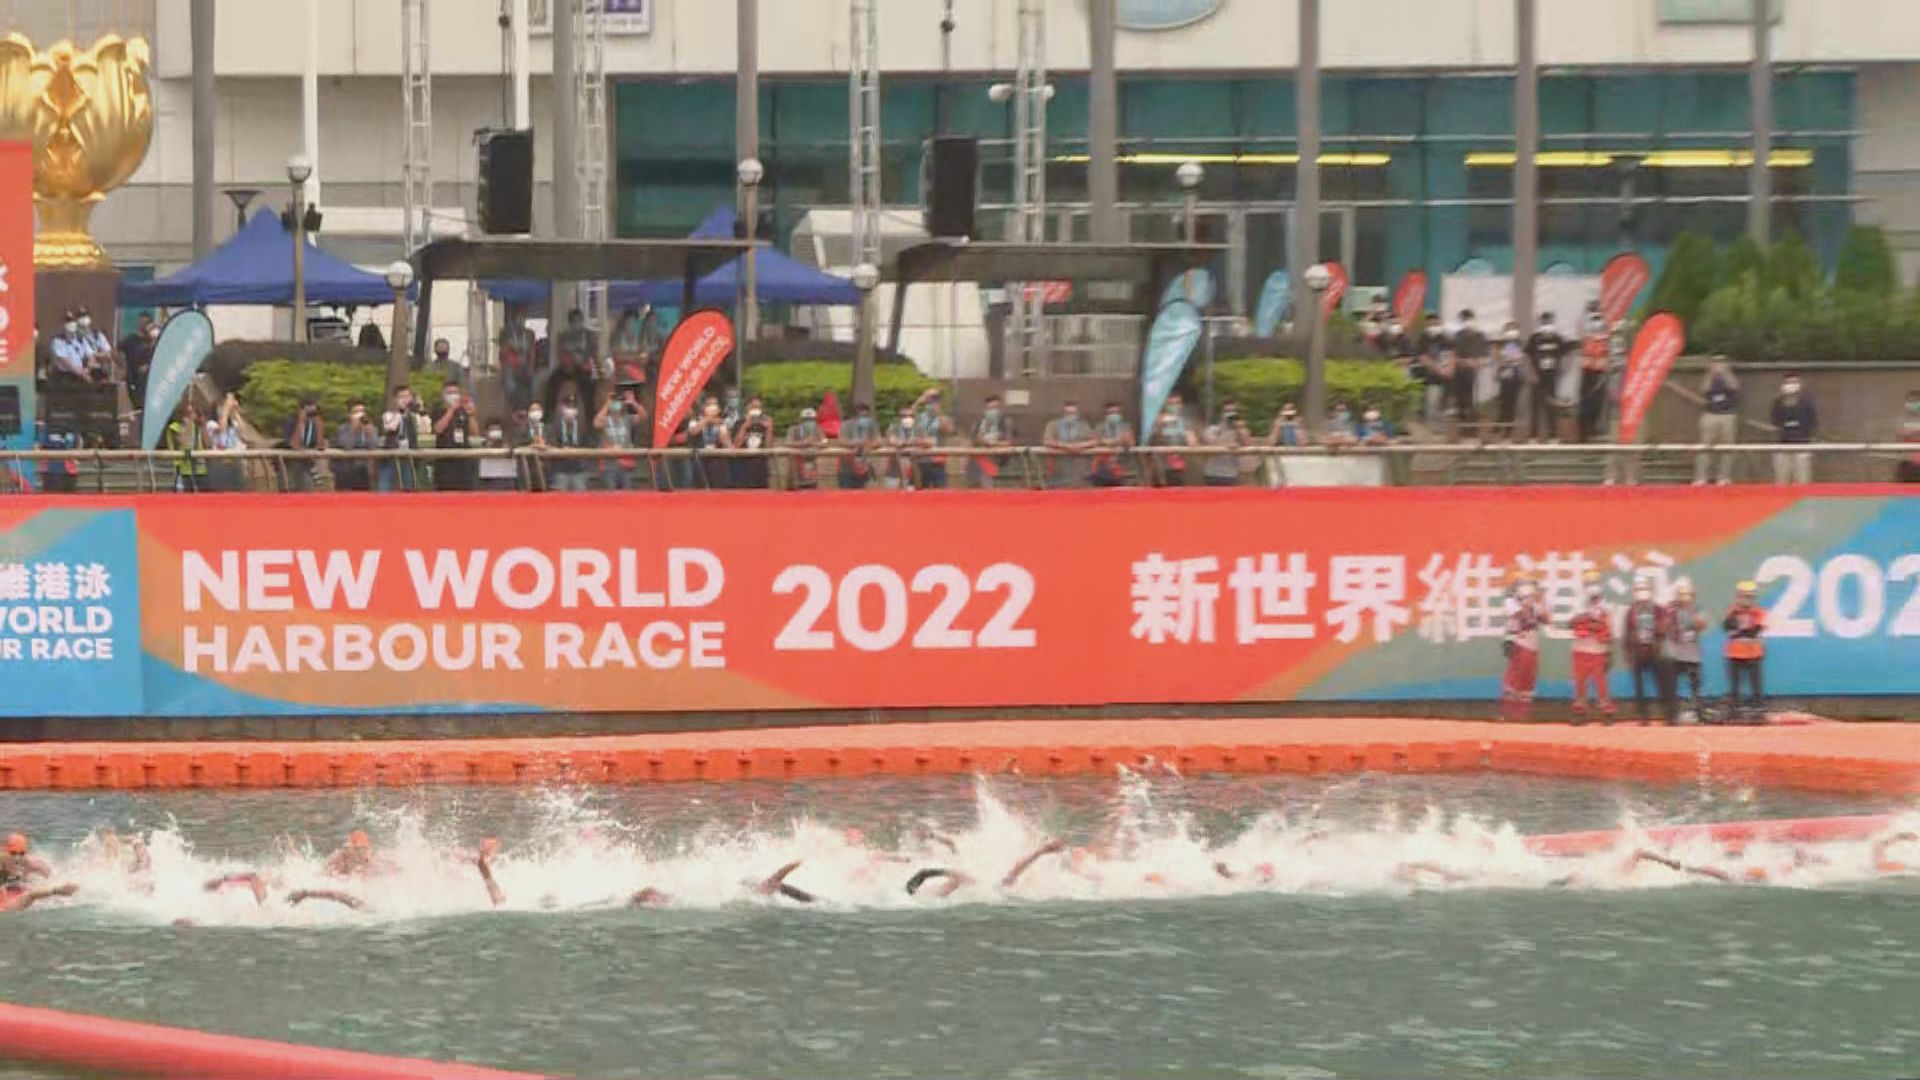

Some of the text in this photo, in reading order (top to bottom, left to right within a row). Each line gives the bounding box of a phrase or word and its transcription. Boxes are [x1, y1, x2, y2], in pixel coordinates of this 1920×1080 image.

[660, 325, 716, 400] NEW WORLD
[182, 546, 726, 612] NEW WORLD
[771, 562, 1037, 651] 2022
[0, 606, 113, 635] ORLD
[31, 637, 114, 661] RACE
[183, 620, 727, 674] HARBOUR RACE
